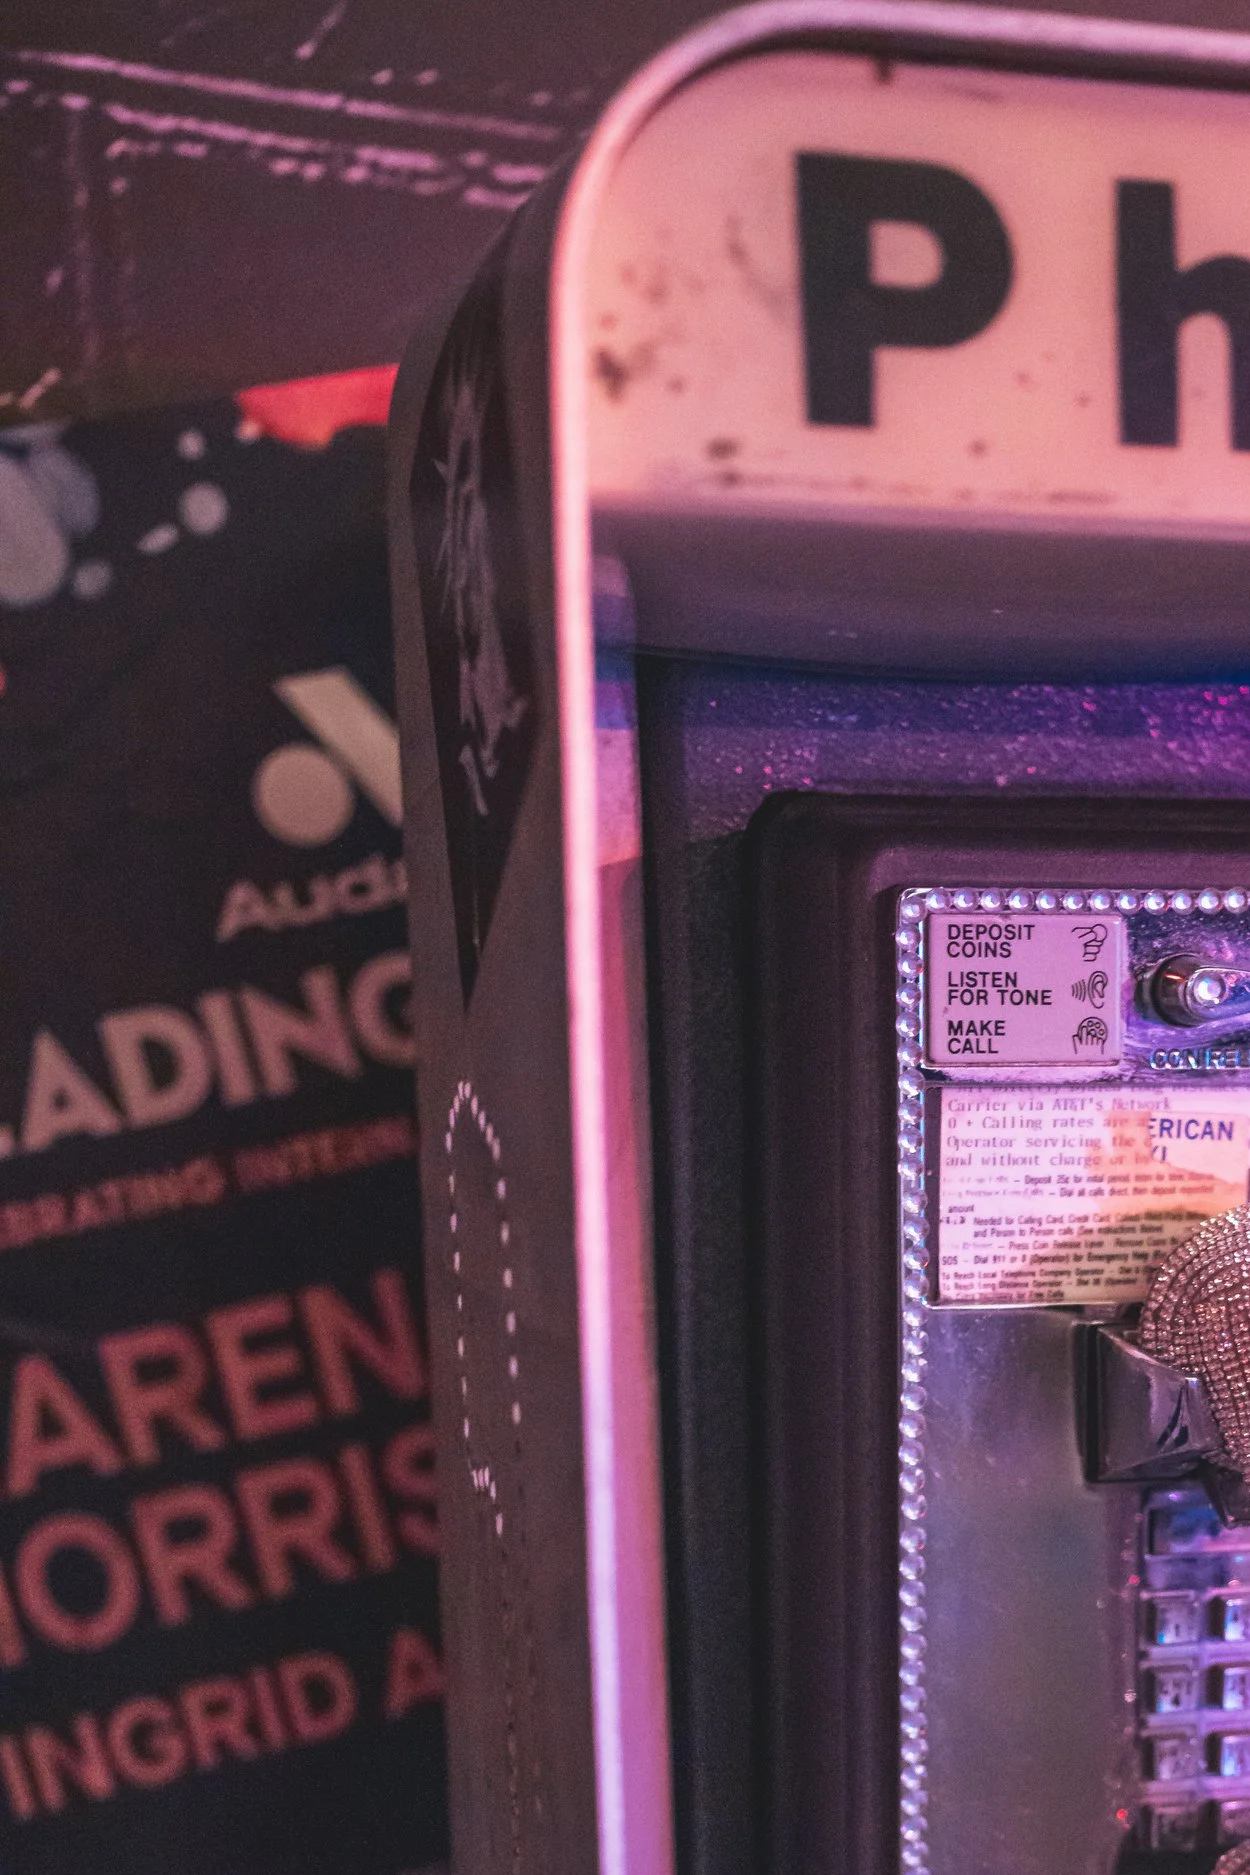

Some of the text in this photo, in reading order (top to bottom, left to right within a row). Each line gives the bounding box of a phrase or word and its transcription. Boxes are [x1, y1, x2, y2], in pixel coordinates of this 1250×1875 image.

[947, 924, 1035, 940] DEPOSIT
[947, 941, 1012, 958] COINS
[947, 971, 1018, 988] LISTEN
[947, 989, 1053, 1006] FOR TONE
[947, 1019, 1006, 1036] MAKE
[947, 1037, 999, 1055] CALL
[947, 1099, 1008, 1112] Carrier
[1017, 1100, 1044, 1111] via
[981, 1116, 1042, 1130] Calling
[1052, 1117, 1095, 1128] rates
[946, 1136, 1015, 1149] Operator
[1025, 1136, 1101, 1149] servicing
[945, 1154, 972, 1167] and
[981, 1154, 1039, 1167] without
[1049, 1154, 1101, 1168] charge
[0, 1422, 442, 1668] ORRIS
[0, 1651, 358, 1820] INGRID
